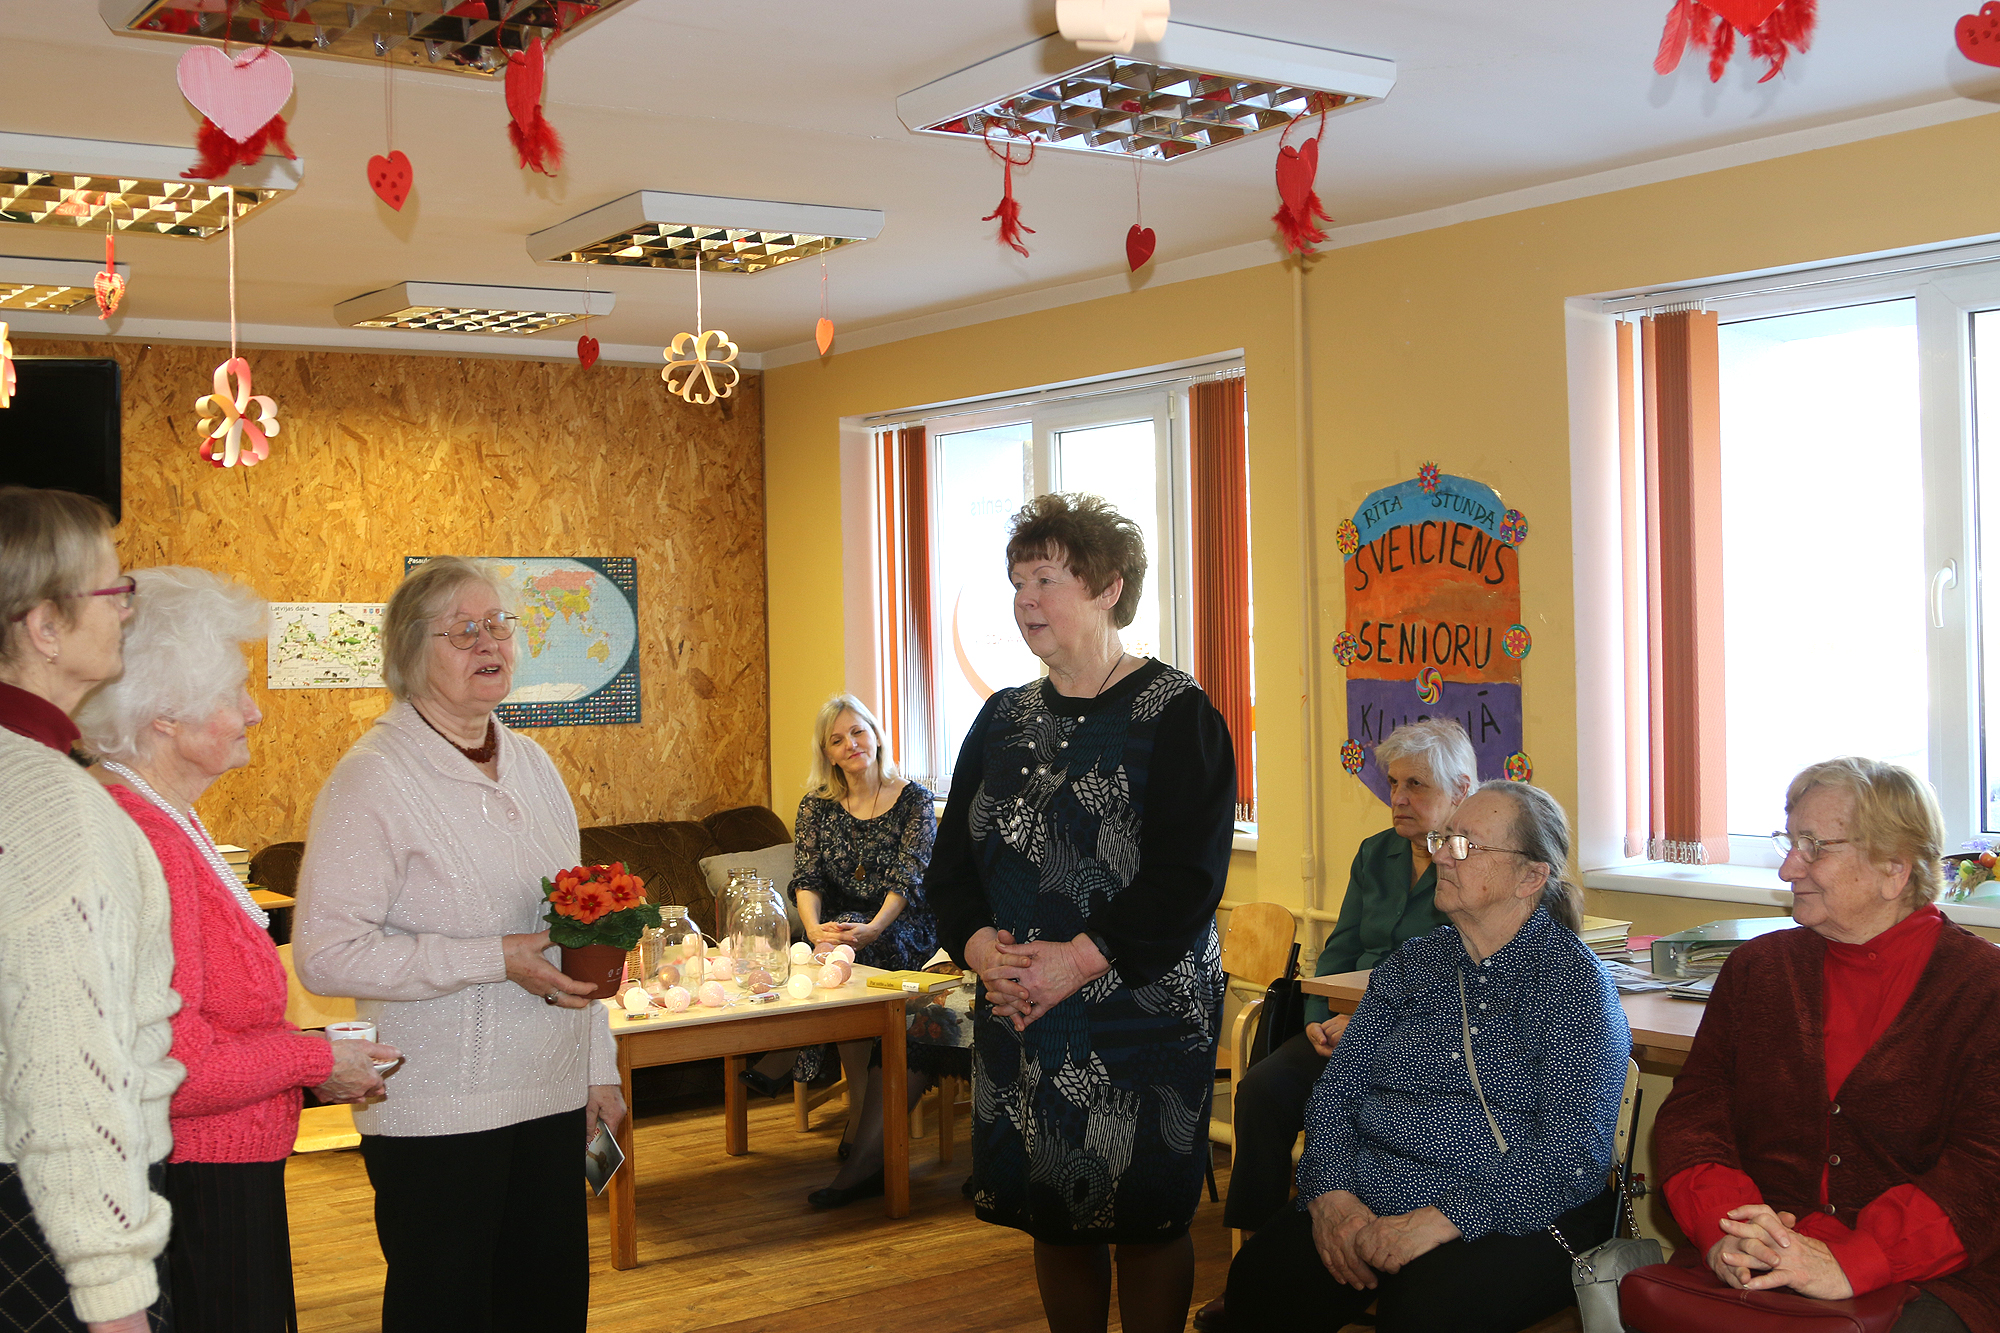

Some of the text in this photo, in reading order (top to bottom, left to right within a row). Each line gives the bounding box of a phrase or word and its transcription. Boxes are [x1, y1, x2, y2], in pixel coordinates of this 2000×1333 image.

[1362, 491, 1496, 531] RĪTA STUNDA
[1354, 520, 1511, 591] SVEICIENS
[1357, 621, 1492, 669] SENIORU
